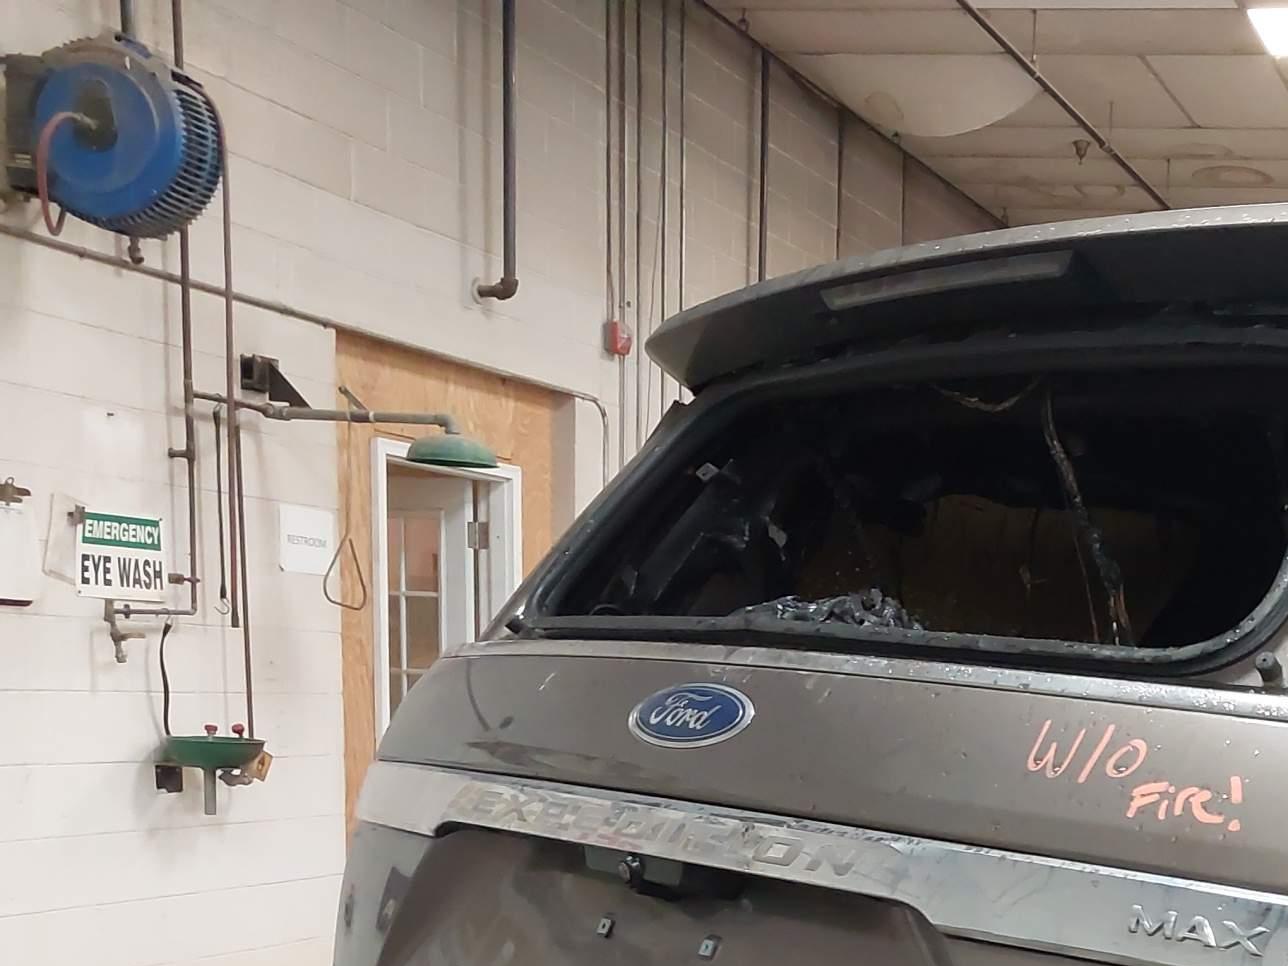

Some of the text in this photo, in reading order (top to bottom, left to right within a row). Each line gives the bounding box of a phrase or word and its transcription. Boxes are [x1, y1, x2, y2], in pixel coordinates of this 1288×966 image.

[85, 519, 160, 545] EMERGENCY
[81, 553, 164, 591] EYE WASH
[649, 692, 722, 730] Ford
[1026, 719, 1148, 783] W/O
[1127, 904, 1270, 957] MAX
